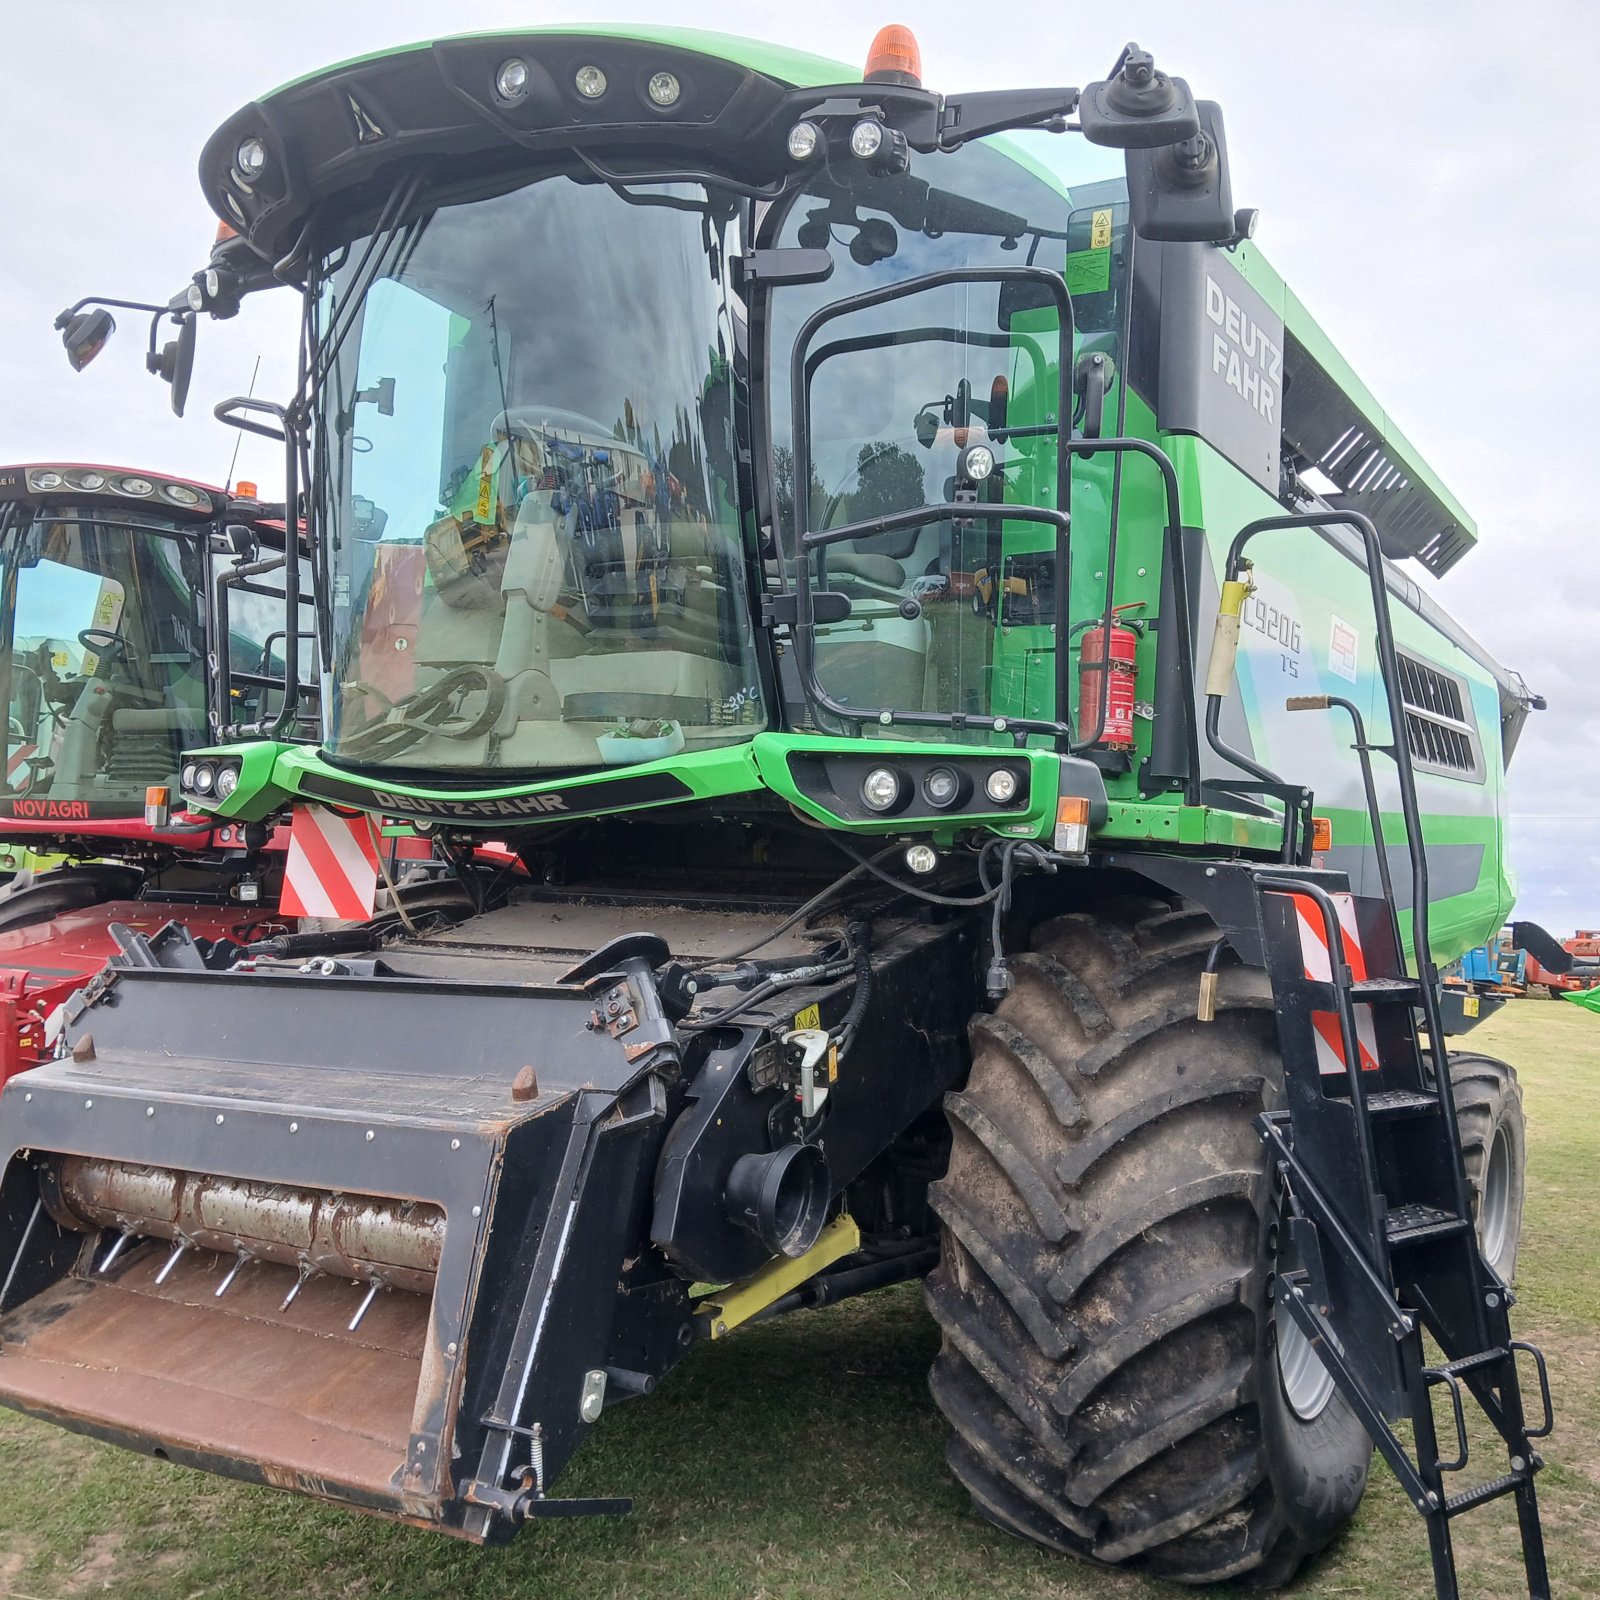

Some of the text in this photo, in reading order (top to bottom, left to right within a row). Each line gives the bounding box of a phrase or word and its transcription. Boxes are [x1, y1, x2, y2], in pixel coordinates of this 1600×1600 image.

[1206, 275, 1282, 388] DEUTZ
[1212, 332, 1275, 425] FAHR
[1243, 595, 1303, 655] C9206
[13, 799, 90, 819] NOVAGRI
[371, 790, 570, 815] DEUTZ-FAHR
